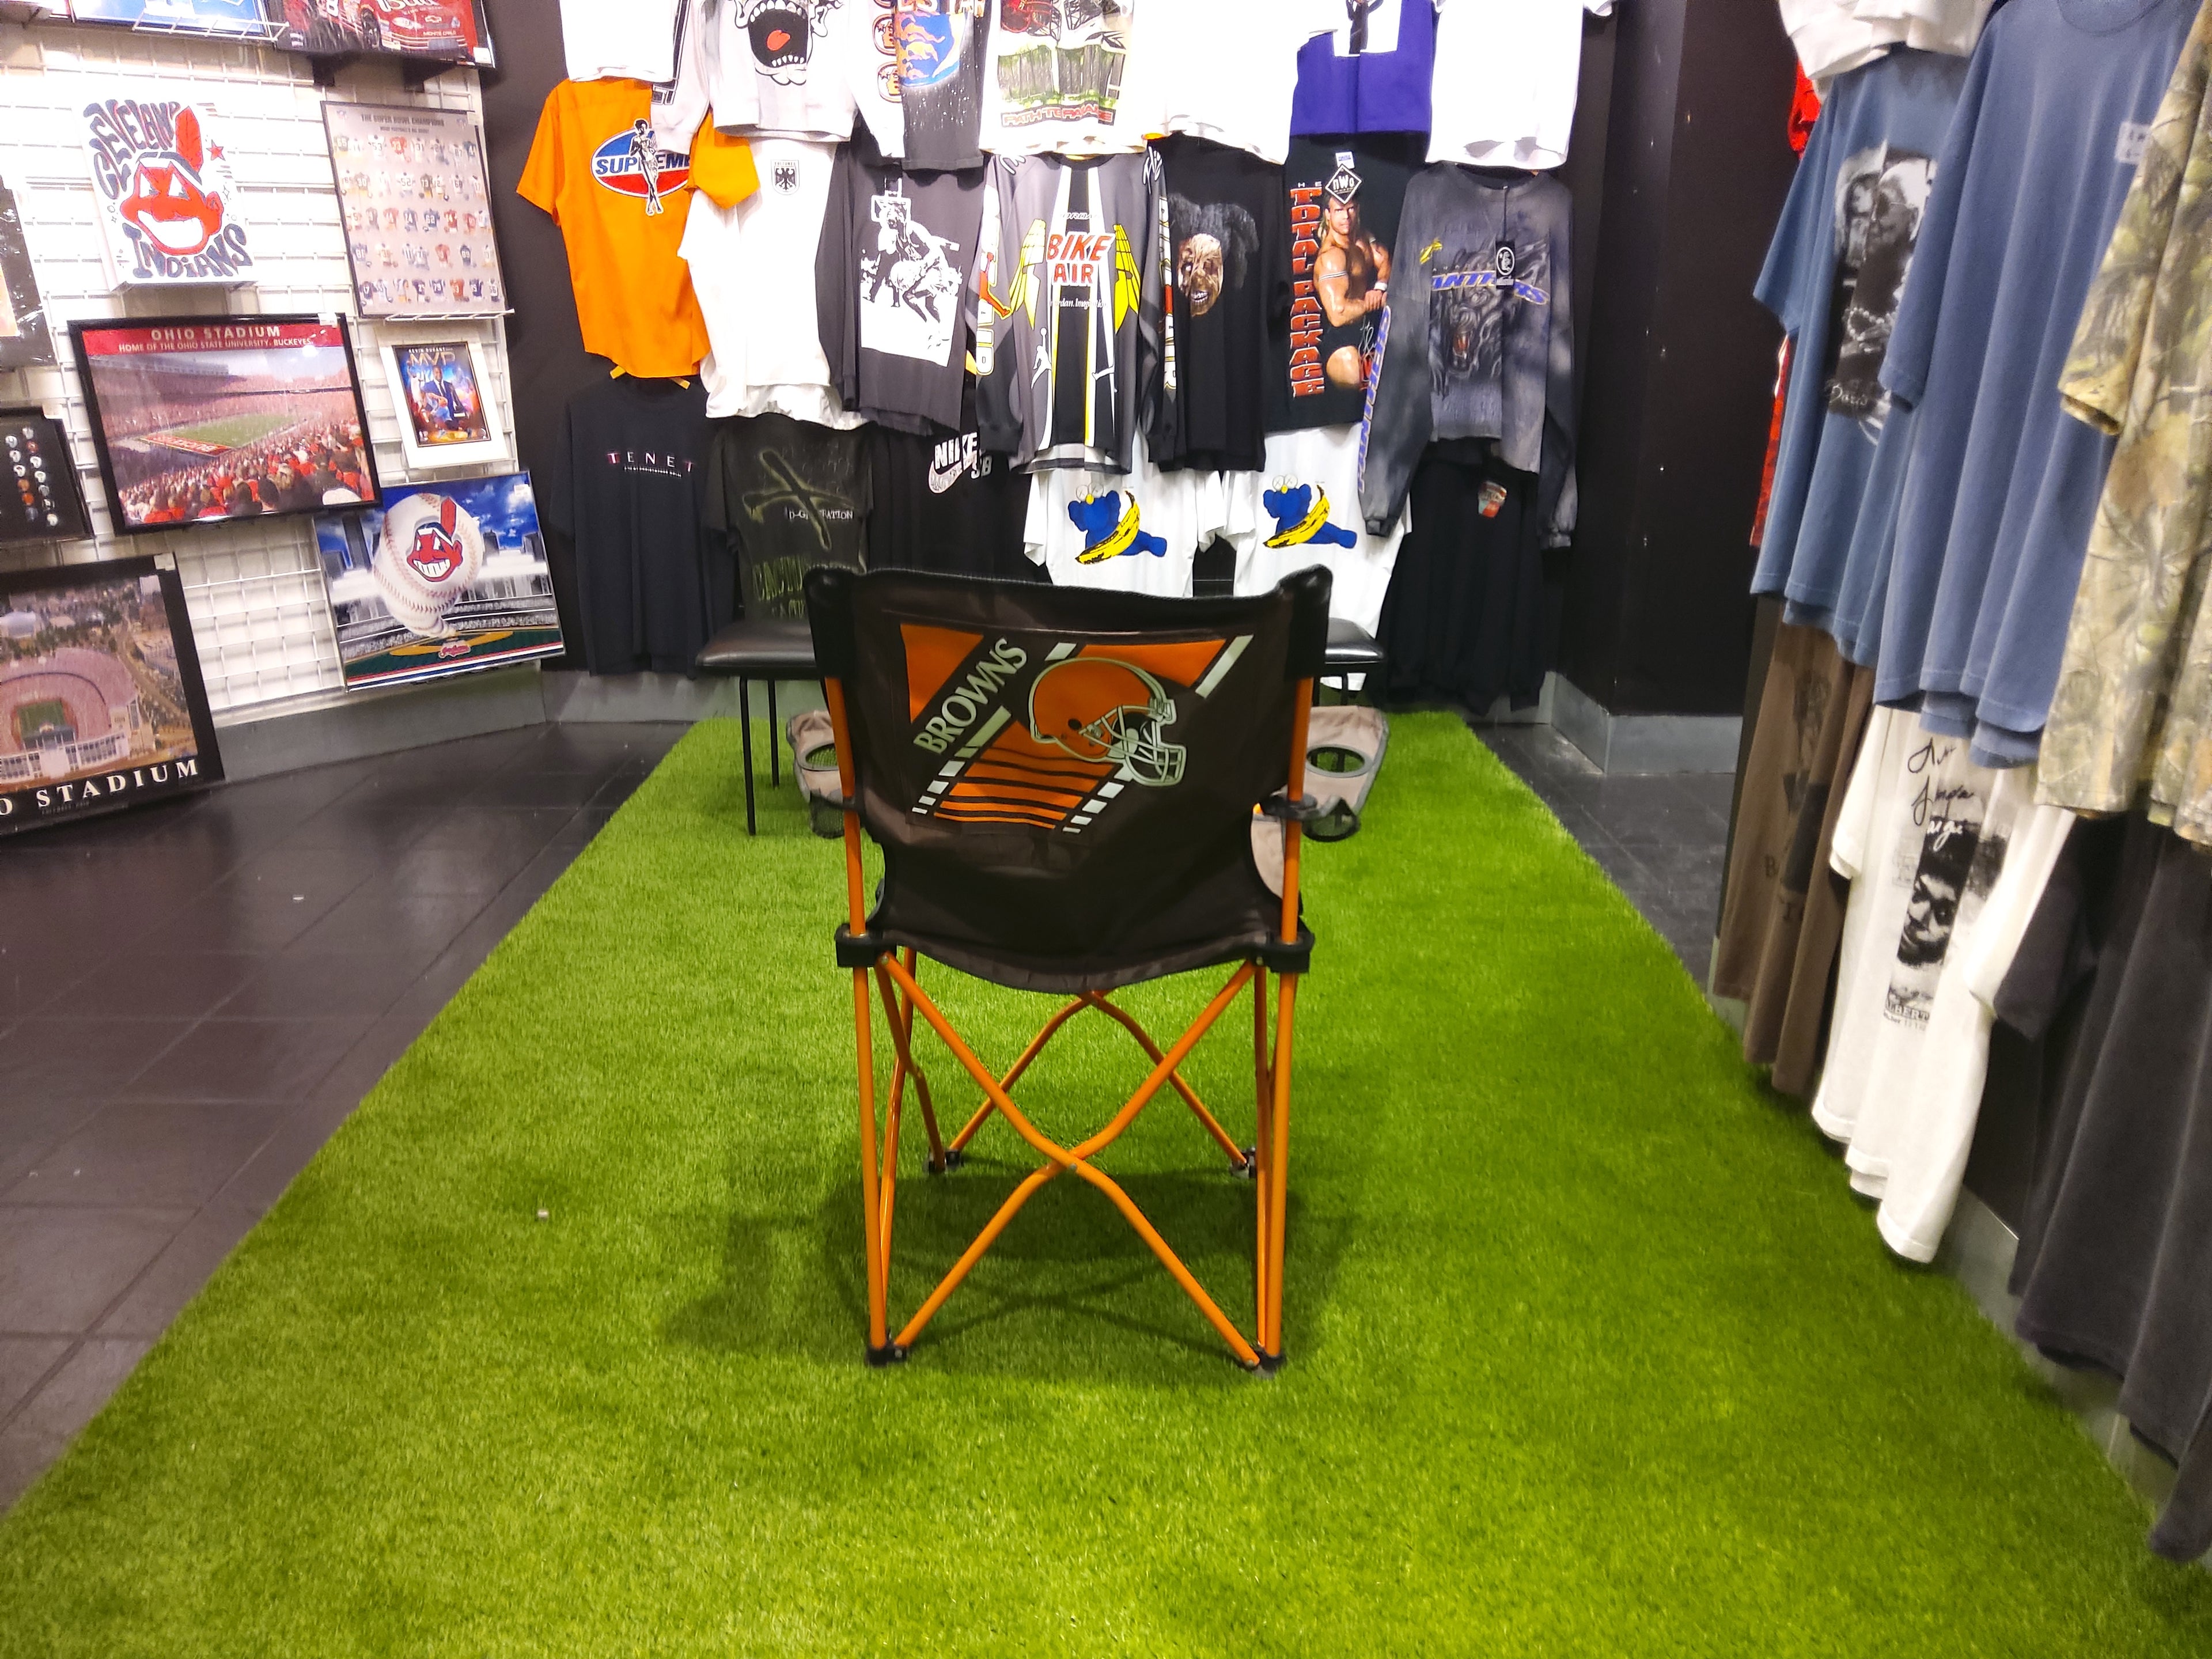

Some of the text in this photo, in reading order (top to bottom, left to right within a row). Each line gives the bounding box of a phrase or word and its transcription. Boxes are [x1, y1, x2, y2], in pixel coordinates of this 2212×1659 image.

[596, 154, 690, 175] SUPEM
[1332, 175, 1355, 191] nWo
[1290, 187, 1323, 275] TOTAL
[1047, 234, 1112, 261] BIKE
[1054, 263, 1094, 284] AIR
[151, 326, 281, 340] OHIO STADIUM
[1290, 280, 1325, 397] PACKAGE
[119, 343, 143, 352] HOME
[410, 351, 455, 366] MVP
[607, 450, 695, 472] TENET
[934, 432, 978, 470] NIKE
[789, 510, 854, 522] D-GRATION
[912, 638, 1027, 755] BROWNS
[36, 759, 198, 808] STADIUM
